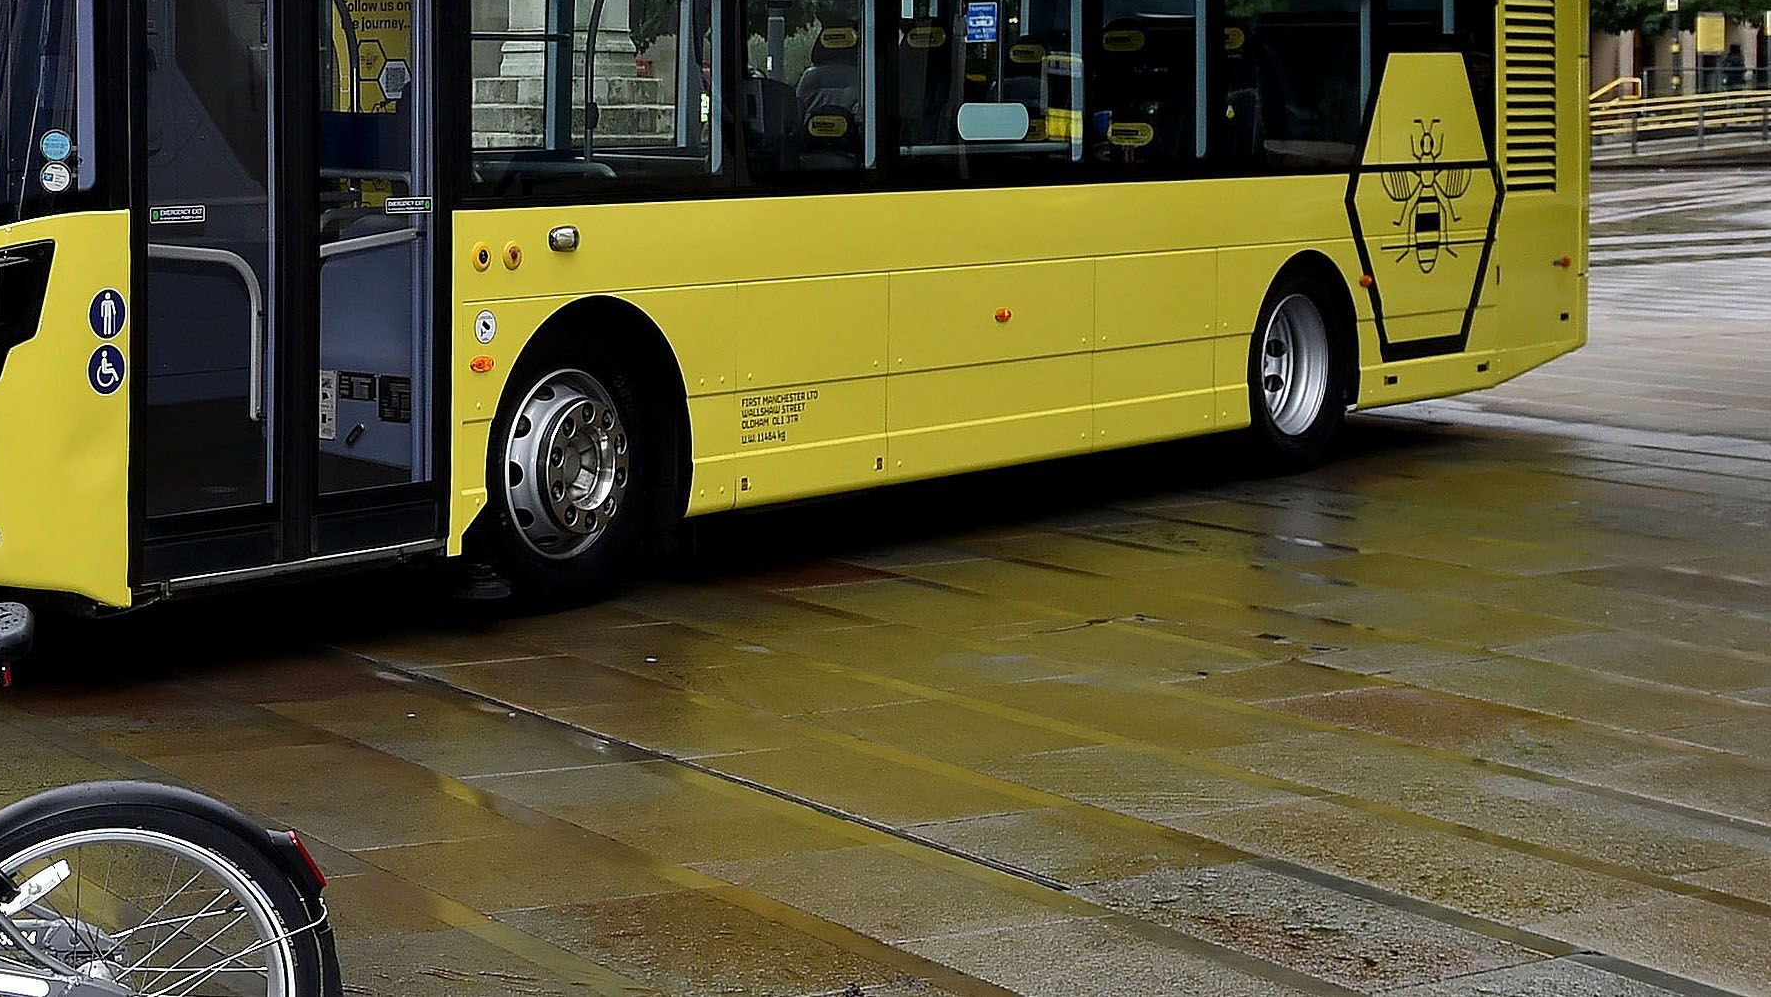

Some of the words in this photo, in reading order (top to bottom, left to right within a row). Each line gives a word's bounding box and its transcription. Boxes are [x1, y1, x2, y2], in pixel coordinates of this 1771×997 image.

[380, 2, 394, 12] us
[741, 397, 761, 408] FIRST
[762, 392, 805, 405] MANCHESTER
[807, 390, 818, 400] LTD
[782, 403, 805, 414] STREET
[741, 418, 769, 430] OLDHAM
